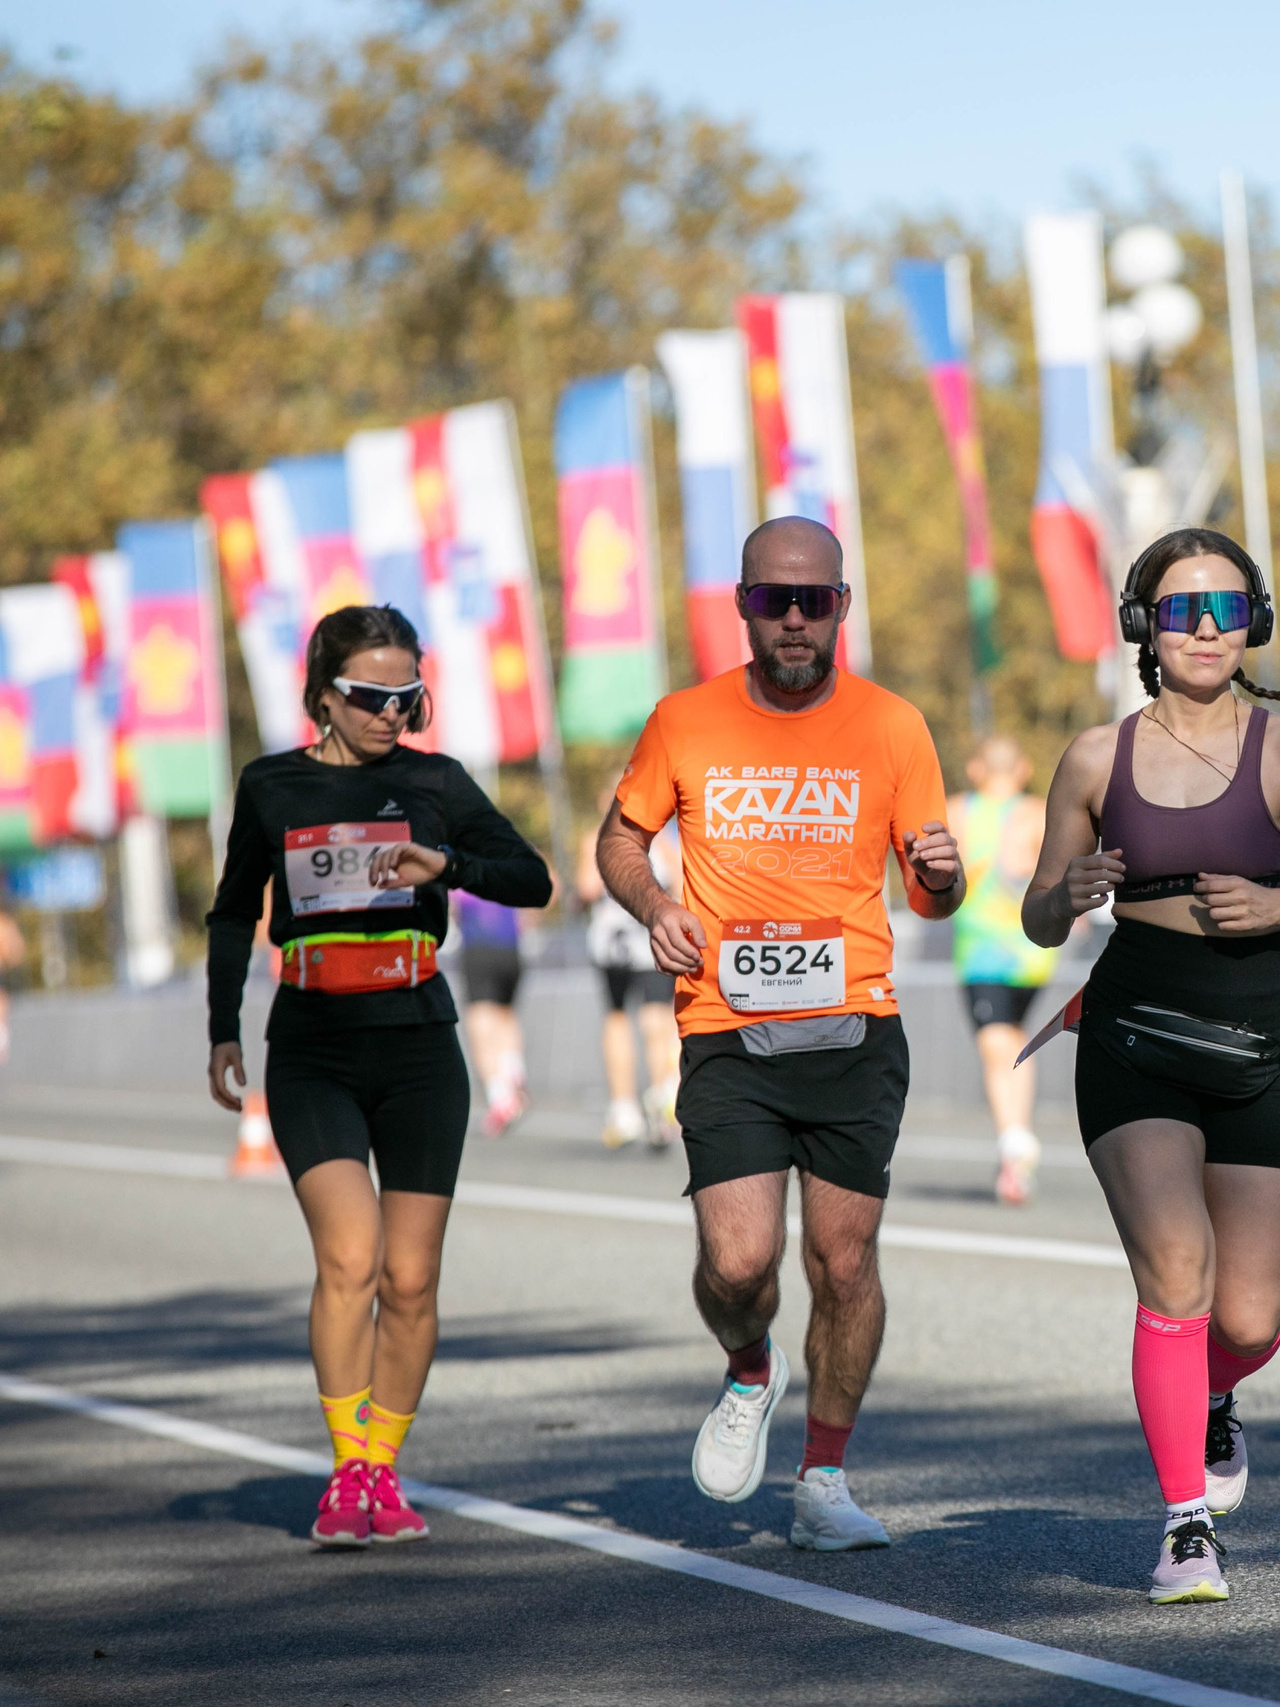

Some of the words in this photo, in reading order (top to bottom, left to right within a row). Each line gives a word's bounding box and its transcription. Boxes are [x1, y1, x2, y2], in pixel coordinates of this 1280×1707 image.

[704, 766, 734, 778] AK
[741, 766, 798, 779] BARS
[805, 767, 861, 781] BANK
[704, 779, 860, 825] KAZAN
[705, 822, 854, 844] MARATHON
[708, 843, 853, 880] 2021
[733, 925, 751, 934] 42.2
[733, 943, 834, 976] 6524
[761, 977, 803, 987] ЕВГЕНИЙ
